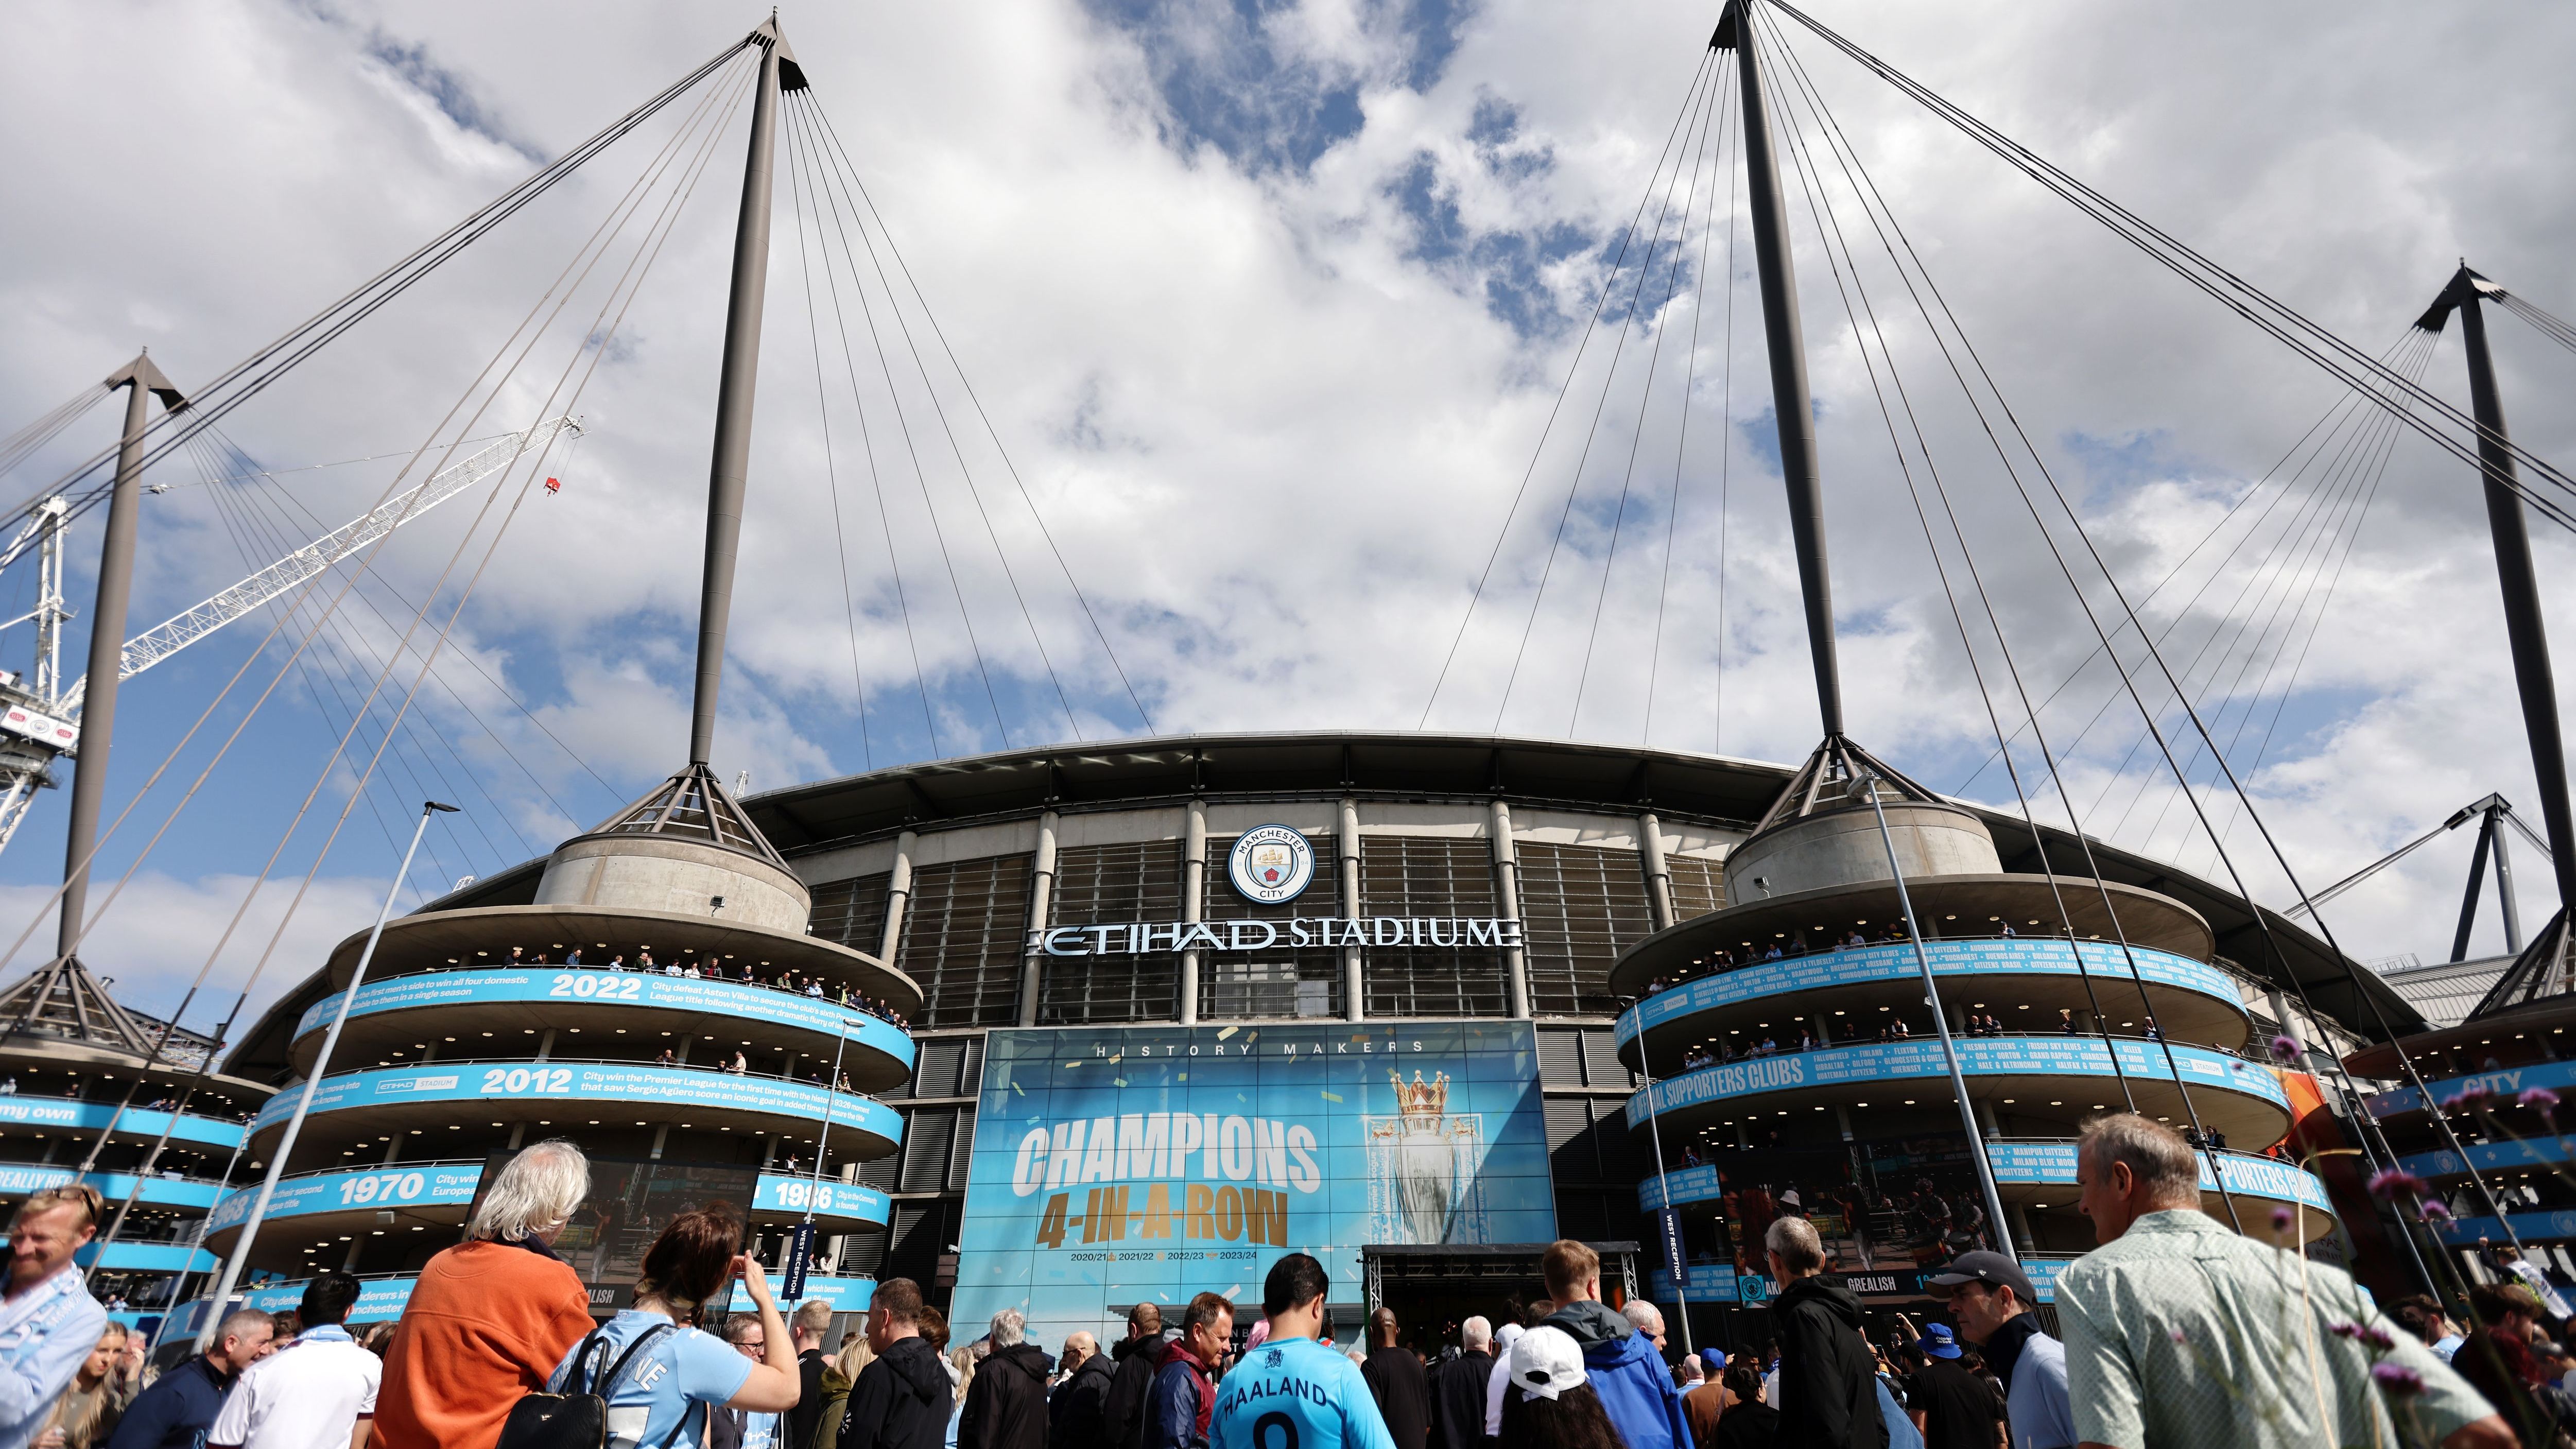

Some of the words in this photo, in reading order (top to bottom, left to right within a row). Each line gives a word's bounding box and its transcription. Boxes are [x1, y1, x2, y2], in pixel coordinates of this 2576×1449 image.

[1239, 830, 1305, 854] MANCHESTER
[1044, 920, 1276, 956] ETIHAD
[1290, 917, 1503, 947] STADIUM
[1866, 959, 1894, 968] BRISBANE
[1872, 968, 1889, 976] BLUES
[385, 985, 407, 993] men's
[485, 976, 528, 985] domestic
[550, 974, 641, 999] 2022
[414, 991, 439, 999] single
[652, 982, 671, 992] City
[673, 983, 702, 994] defeat
[703, 988, 729, 997] Aston
[732, 991, 749, 1001] Villa
[760, 998, 786, 1007] secure
[787, 1001, 799, 1010] the
[800, 1006, 819, 1015] club's
[820, 1009, 835, 1019] sixth
[1667, 997, 1685, 1008] STADIUM
[650, 992, 684, 1002] League
[685, 996, 703, 1005] title
[704, 997, 744, 1011] following
[745, 1006, 775, 1015] another
[776, 1009, 808, 1022] dramatic
[809, 1016, 827, 1027] flurry
[845, 1026, 860, 1036] goals
[1096, 1045, 1250, 1057] HISTORY
[1284, 1041, 1422, 1054] MAKERS
[1813, 1052, 1849, 1062] FALLOWFIELD
[1859, 1049, 1883, 1058] FINLAND
[1894, 1046, 1917, 1055] FLIXTON
[2122, 1045, 2142, 1054] GELEEN
[1815, 1061, 1844, 1071] GIBRALTAR
[1853, 1059, 1876, 1067] GILFORD
[1884, 1056, 1921, 1065] GLOUCESTER
[1817, 1070, 1849, 1080] GUATEMALA
[1851, 1068, 1877, 1077] CITYZENS
[1891, 1064, 1921, 1074] GUERNSEY
[2127, 1064, 2148, 1073] HALTON
[2196, 1063, 2220, 1072] STADIUM
[480, 1068, 572, 1093] 2012
[1667, 1066, 1745, 1107] SUPPORTERS
[1748, 1058, 1804, 1090] CLUBS
[2463, 1071, 2522, 1093] CITY
[583, 1072, 604, 1081] City
[606, 1073, 624, 1081] win
[626, 1074, 643, 1082] the
[644, 1075, 682, 1084] Premier
[684, 1077, 716, 1089] League
[718, 1081, 731, 1090] for
[732, 1083, 745, 1091] the
[747, 1084, 763, 1093] first
[765, 1086, 781, 1096] time
[783, 1090, 798, 1098] with
[799, 1092, 810, 1100] the
[811, 1094, 834, 1105] historc
[834, 1099, 851, 1109] 93:20
[851, 1103, 870, 1114] moment
[627, 1084, 658, 1095] Sergio
[659, 1087, 694, 1097] Agüero
[696, 1090, 720, 1098] score
[721, 1093, 732, 1101] an
[734, 1093, 758, 1103] iconic
[759, 1096, 775, 1106] goal
[784, 1100, 806, 1110] added
[807, 1103, 821, 1113] time
[856, 1113, 865, 1122] title
[32, 1108, 76, 1120] own
[1012, 1113, 1320, 1197] CHAMPIONS
[436, 1175, 457, 1184] City
[295, 1184, 325, 1195] second
[340, 1173, 424, 1204] 1970
[432, 1187, 476, 1197] Europea
[776, 1183, 832, 1209] 1986
[837, 1191, 848, 1200] City
[841, 1201, 859, 1210] founded
[1036, 1184, 1287, 1249] 4-IN-A-ROW
[1667, 1215, 1675, 1236] WEST
[799, 1230, 807, 1251] WEST
[1071, 1253, 1106, 1262] 2020/21
[1168, 1252, 1204, 1261] 2022/23
[1220, 1251, 1256, 1260] 2023/24
[1670, 1237, 1681, 1280] RECEPTION
[790, 1252, 803, 1293] RECEPTION
[807, 1283, 823, 1292] which
[824, 1283, 844, 1293] becomes
[1847, 1276, 1896, 1292] GREALISH
[261, 1297, 276, 1307] City
[398, 1290, 408, 1298] in
[351, 1304, 404, 1315] anchester
[1224, 1377, 1326, 1421] HAALAND
